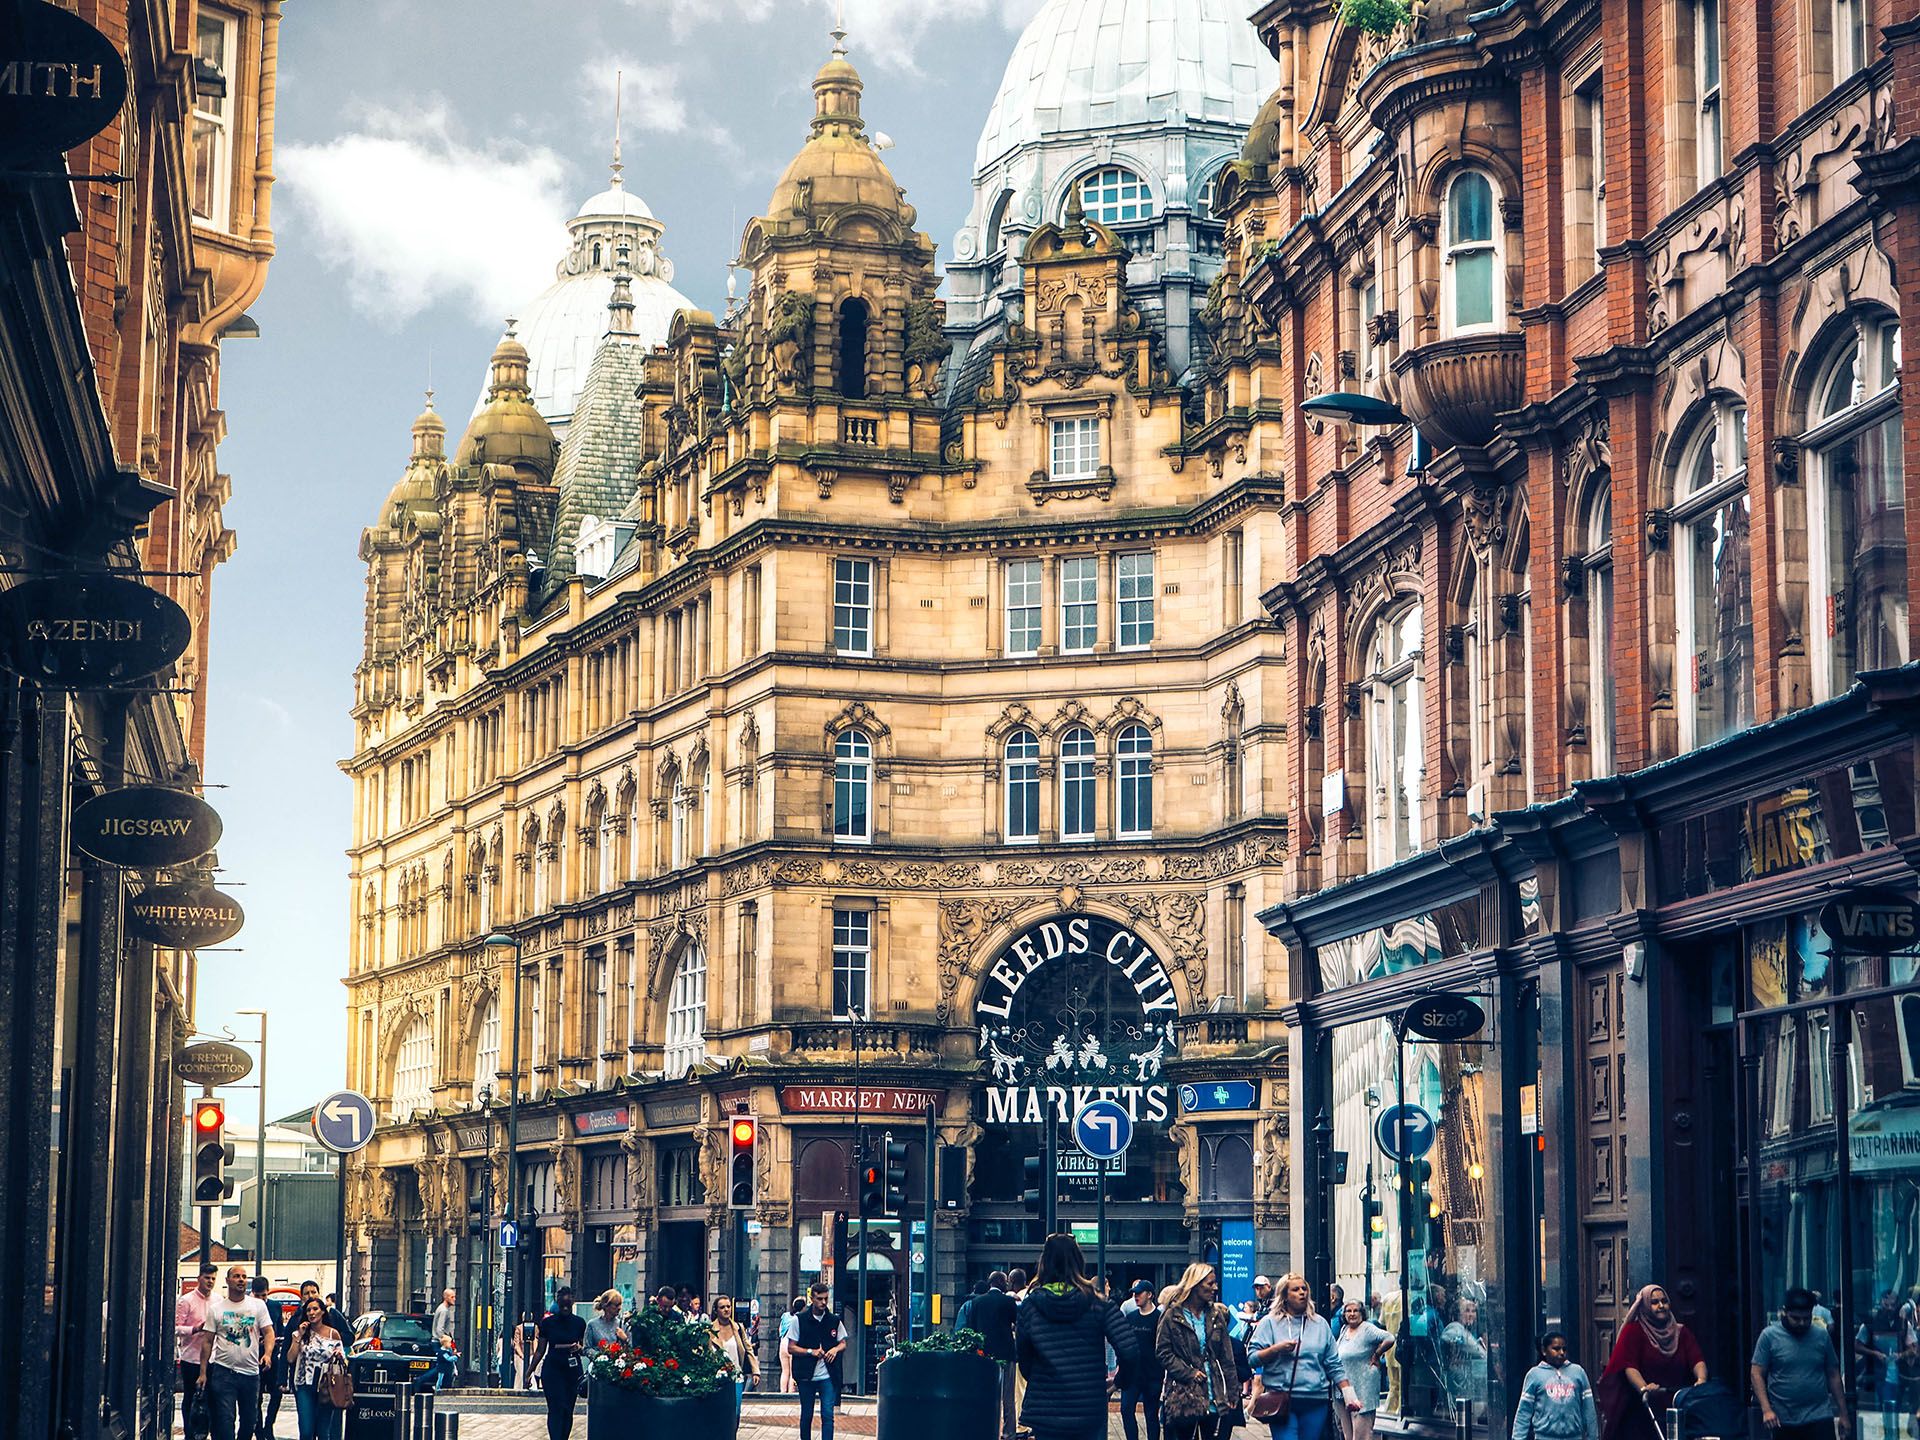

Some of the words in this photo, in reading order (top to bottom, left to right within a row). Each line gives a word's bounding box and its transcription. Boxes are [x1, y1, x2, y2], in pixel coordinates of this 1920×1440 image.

[27, 620, 142, 641] AZENDI
[101, 818, 192, 836] JIGSAW
[1746, 788, 1815, 875] VANS
[133, 904, 237, 921] WHITEWALL
[1836, 904, 1915, 937] VANS
[976, 918, 1090, 1019] LEEDS
[1105, 930, 1178, 1015] CITY
[1422, 1009, 1468, 1027] size?
[191, 1053, 233, 1063] FRENCH
[178, 1063, 245, 1073] CONNECTION
[800, 1090, 886, 1109] MARKET
[1223, 1238, 1253, 1246] welcome
[370, 1409, 396, 1418] Leeds
